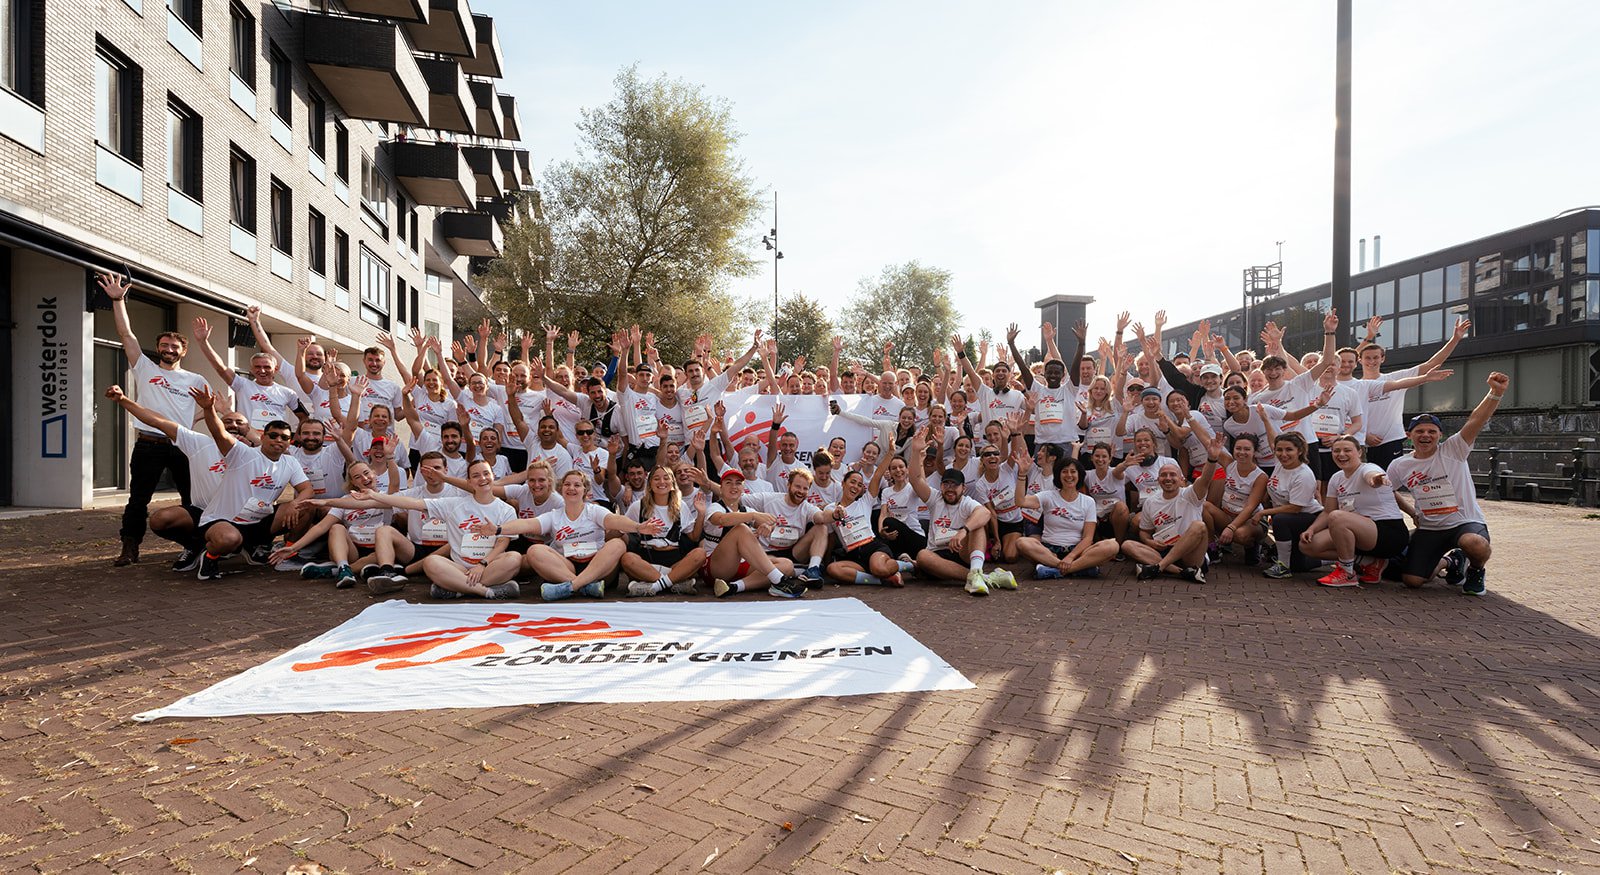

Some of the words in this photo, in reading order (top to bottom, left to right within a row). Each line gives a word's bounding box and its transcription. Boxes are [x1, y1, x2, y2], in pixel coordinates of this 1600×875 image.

[37, 296, 57, 416] westerdok
[58, 342, 68, 410] notariaat
[471, 653, 675, 667] ZONDER
[688, 645, 893, 663] GRENZEN
[521, 641, 694, 654] ARTSEN
